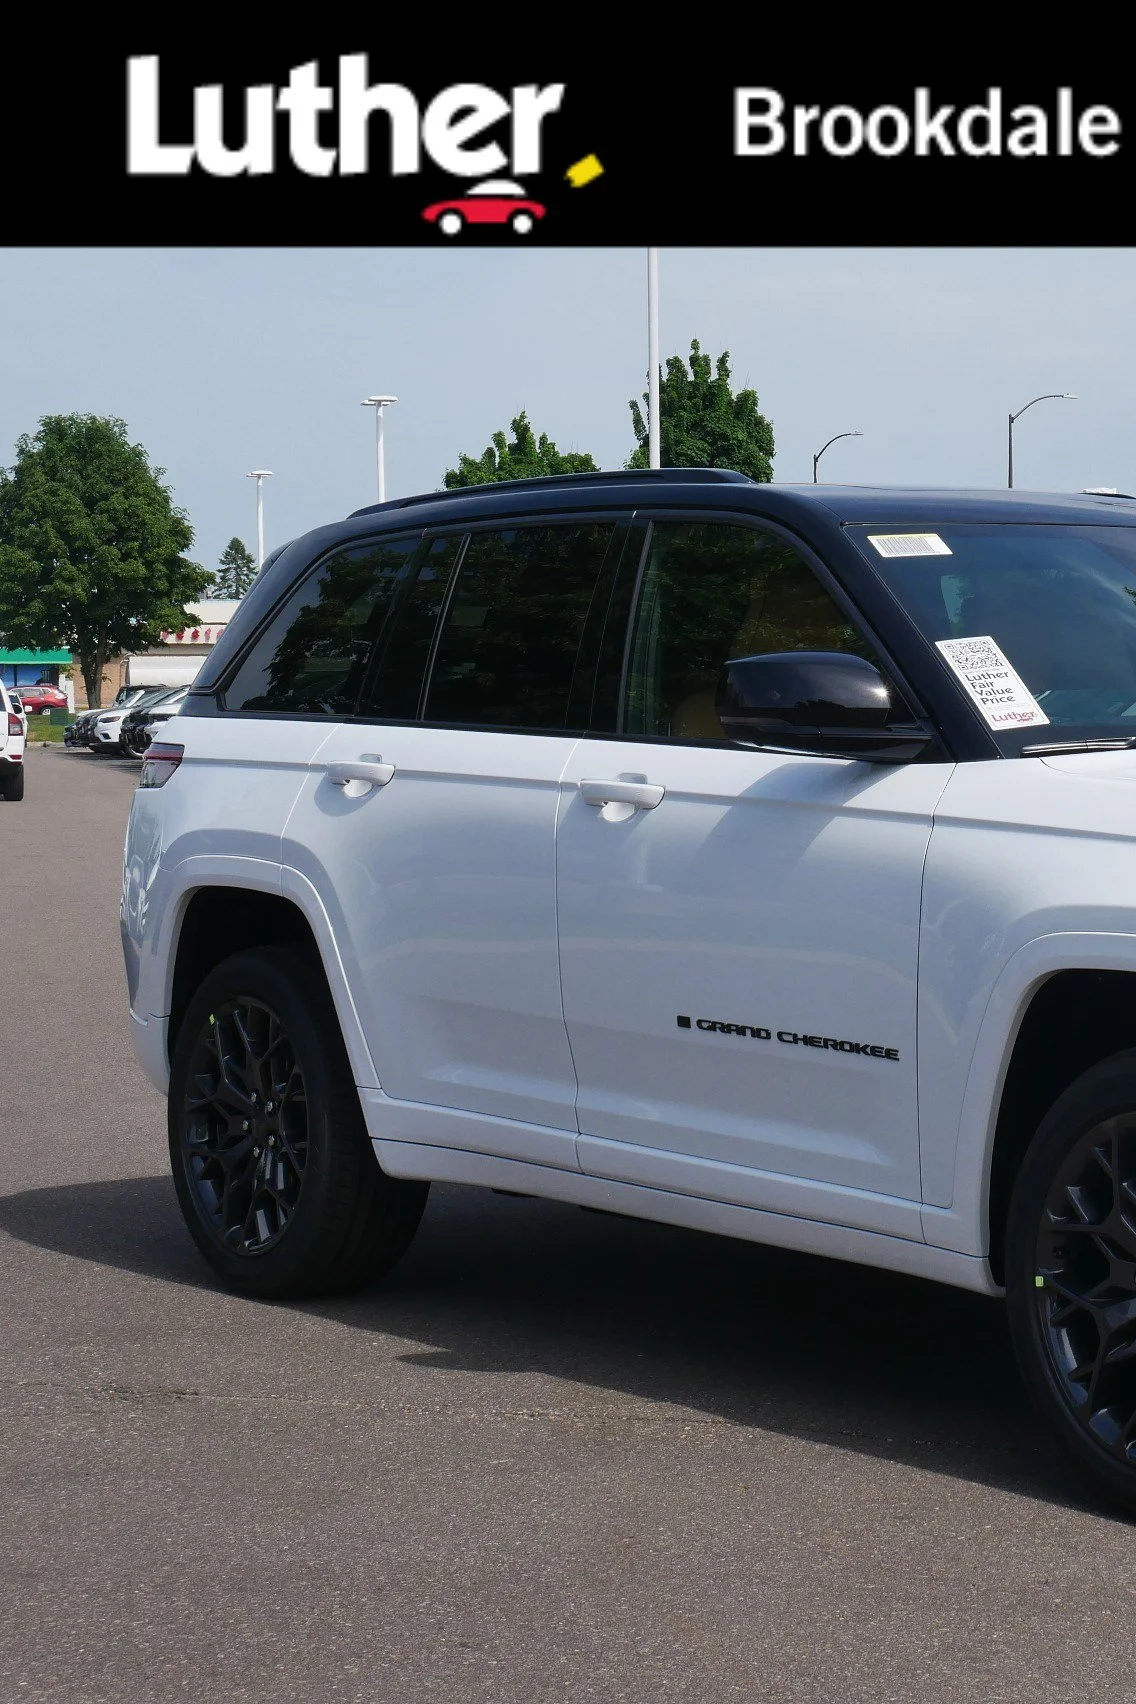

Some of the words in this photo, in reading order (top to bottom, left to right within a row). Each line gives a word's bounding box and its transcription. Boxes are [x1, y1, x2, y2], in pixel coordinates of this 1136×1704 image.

[965, 672, 1009, 682] Luther
[970, 680, 995, 690] Fair
[974, 688, 1013, 697] Value
[980, 696, 1015, 705] Price
[992, 712, 1035, 722] Luther
[696, 1018, 772, 1041] GRAND
[776, 1031, 900, 1061] CHEROKEE
